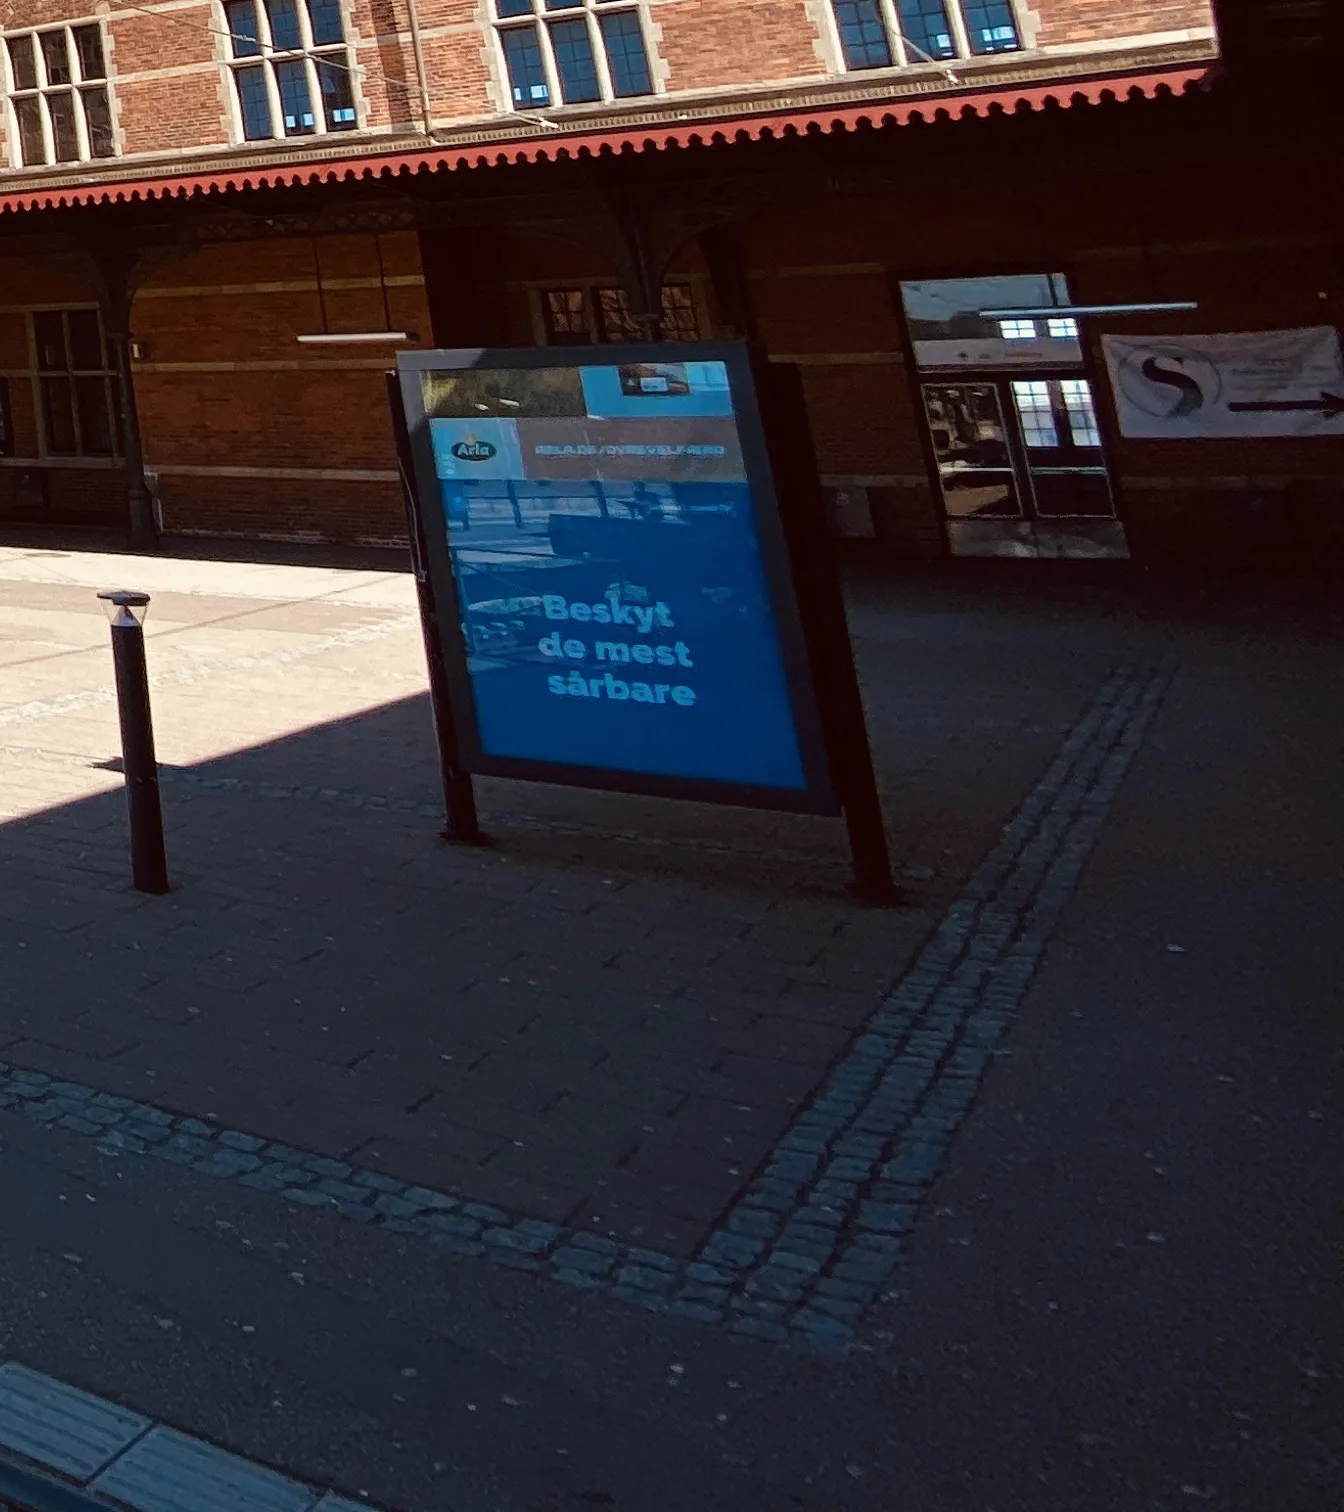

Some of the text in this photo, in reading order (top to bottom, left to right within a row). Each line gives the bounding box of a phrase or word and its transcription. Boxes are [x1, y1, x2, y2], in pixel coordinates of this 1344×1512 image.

[457, 443, 490, 457] Arla
[542, 592, 675, 634] Beskyt
[537, 631, 694, 668] de mest
[547, 670, 698, 706] sårbare
